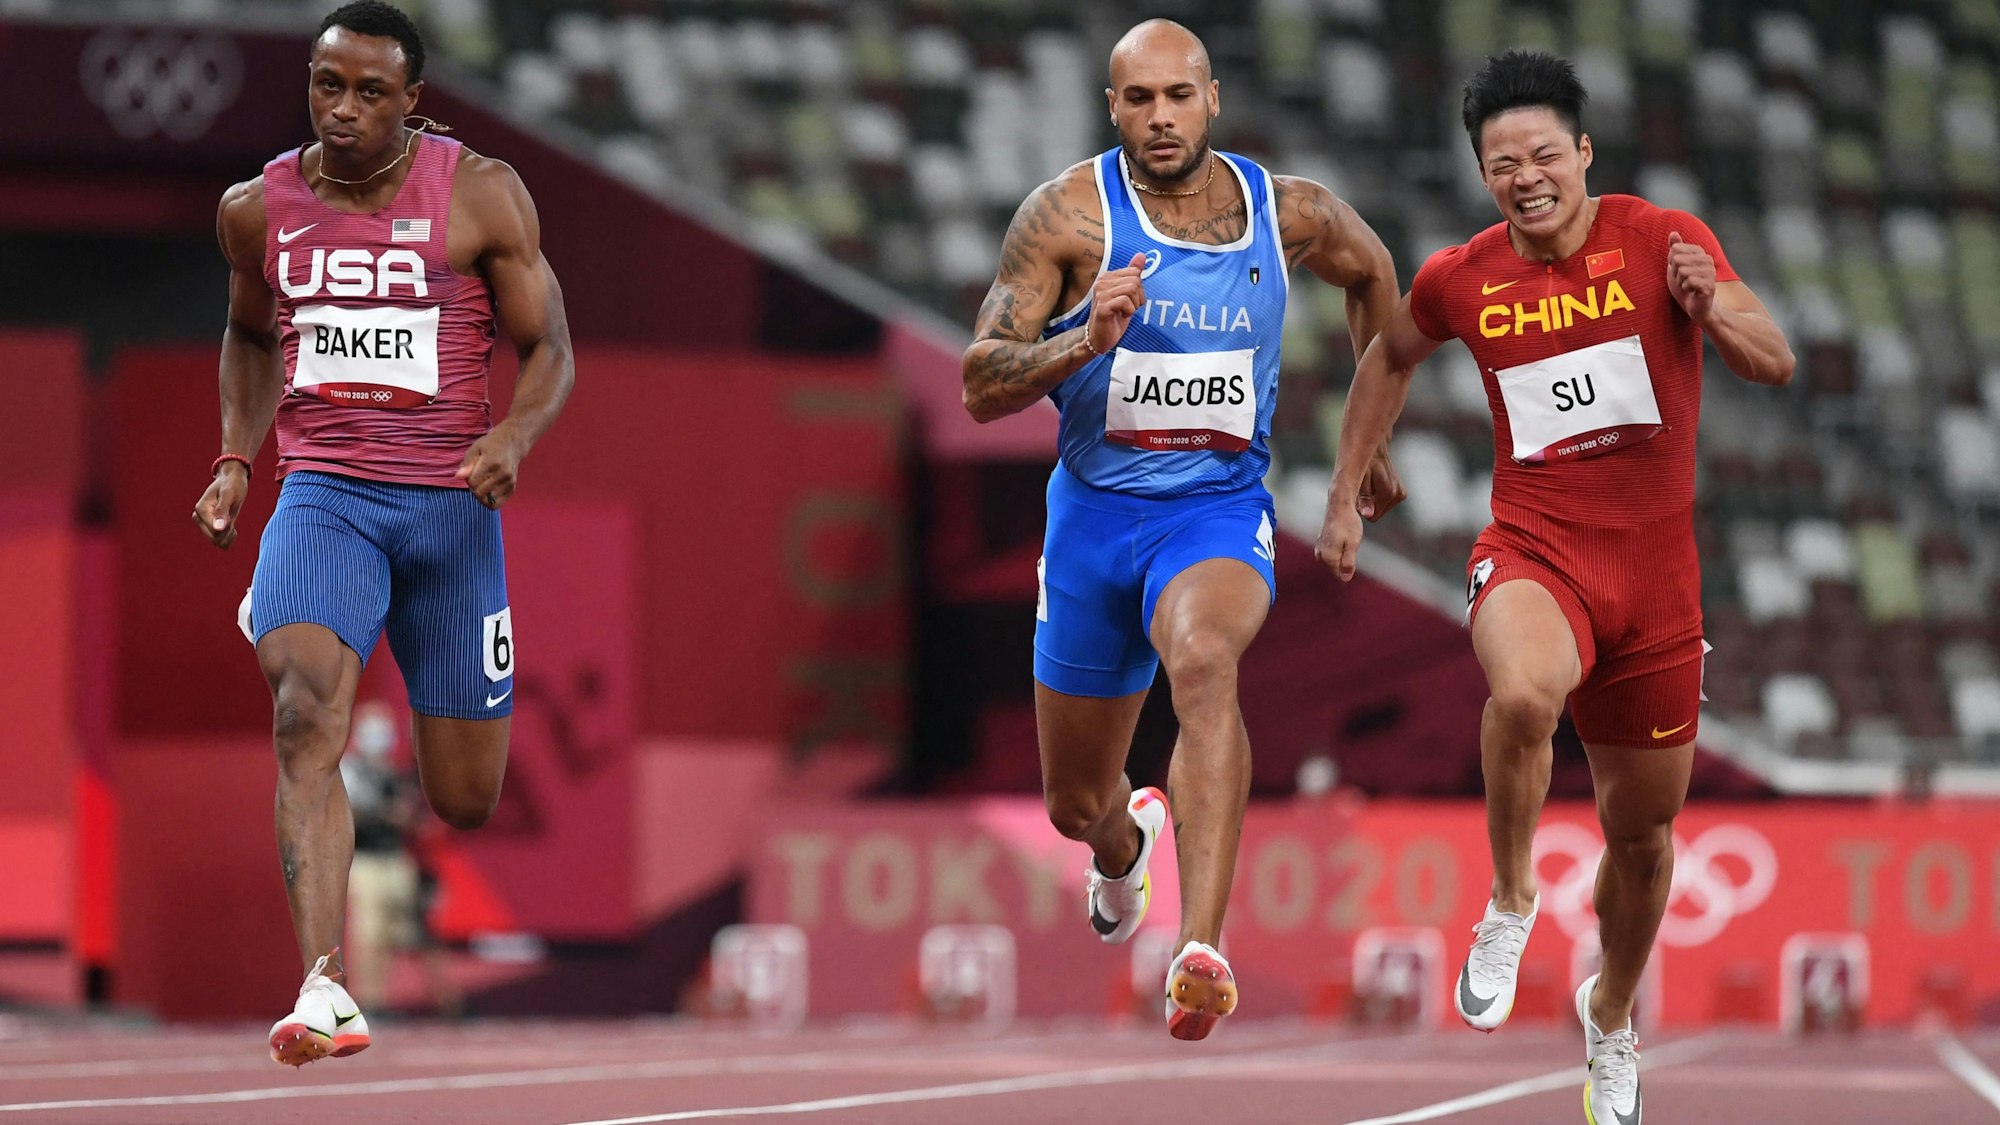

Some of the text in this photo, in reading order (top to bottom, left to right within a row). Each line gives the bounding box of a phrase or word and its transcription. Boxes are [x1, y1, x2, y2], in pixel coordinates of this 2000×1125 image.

[278, 249, 429, 298] USA
[1142, 299, 1252, 333] ITALIA
[1479, 279, 1636, 339] CHINA
[314, 325, 414, 360] BAKER
[330, 389, 370, 400] TOKYO 2020
[1122, 375, 1245, 407] JACOBS
[1551, 373, 1596, 412] SU
[1149, 436, 1190, 445] TOKYO 2020
[1557, 439, 1597, 456] TOKYO 2020
[493, 620, 510, 671] 6
[772, 832, 1461, 933] TOKY 020
[1832, 838, 2000, 936] TO
